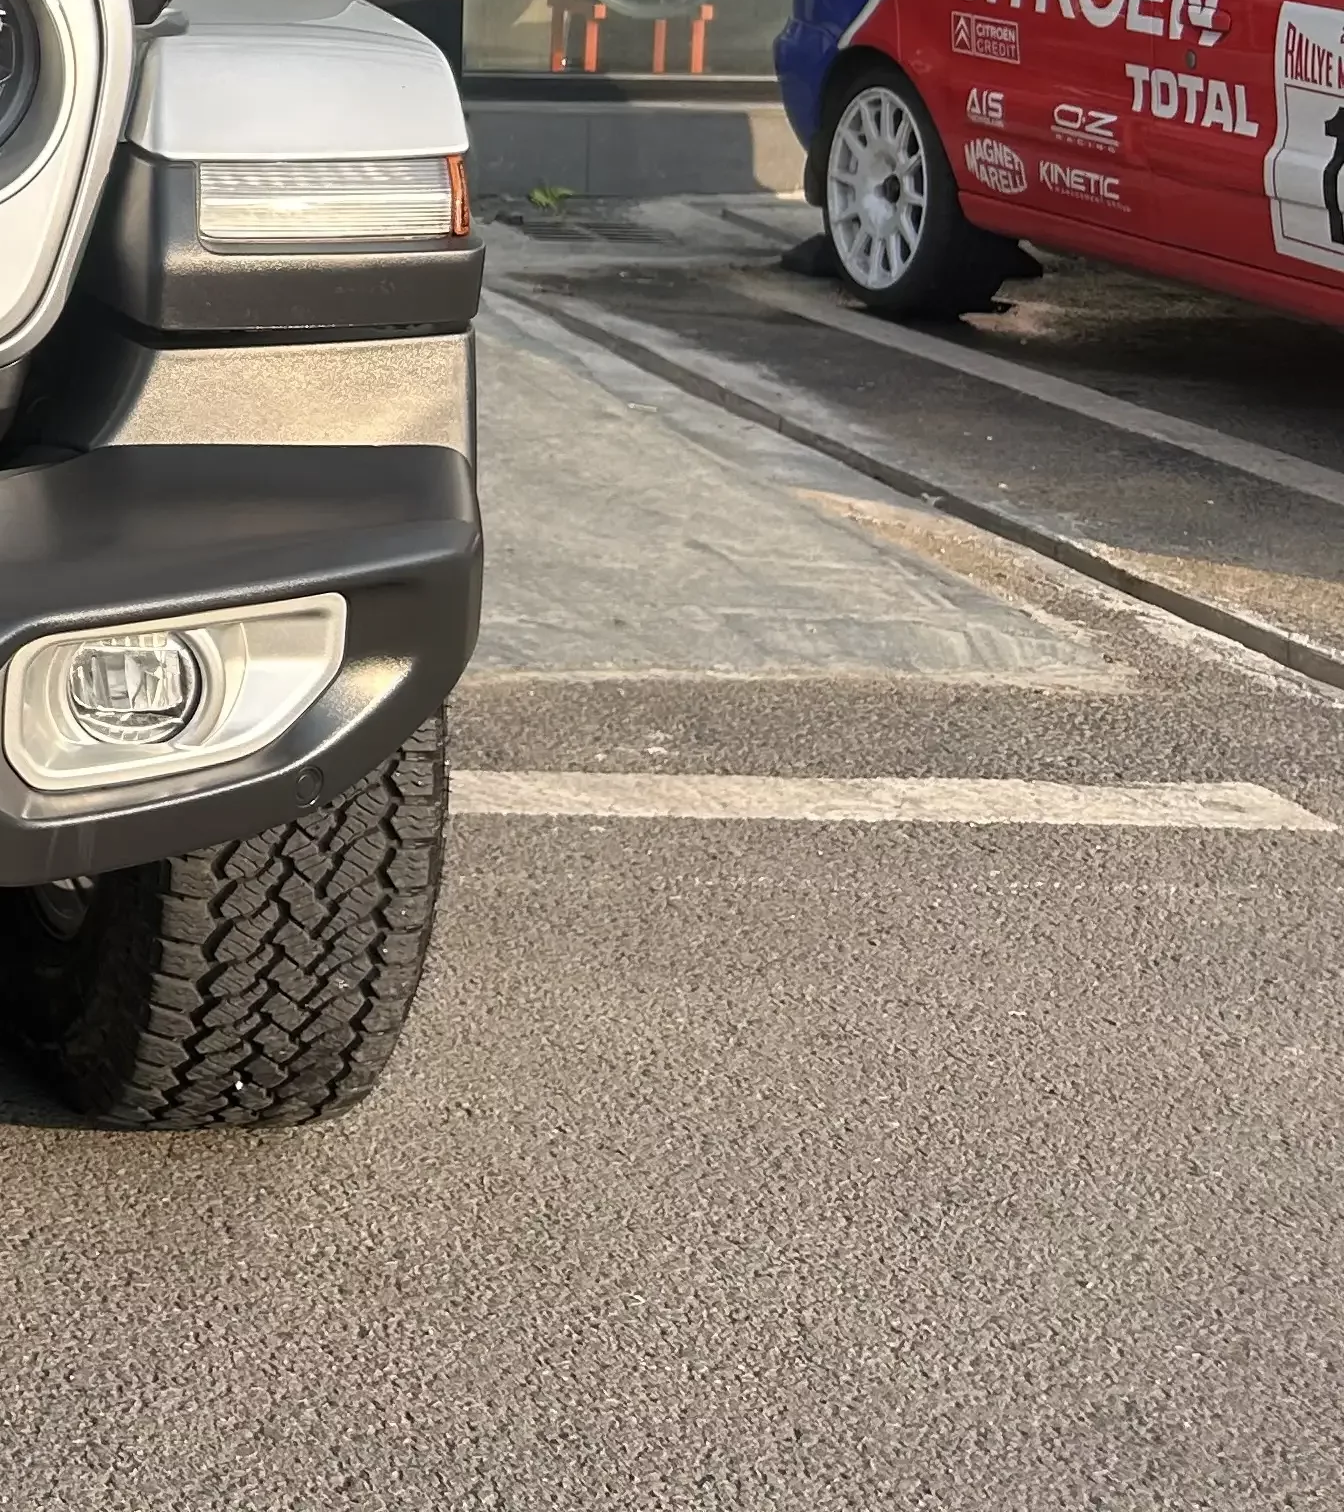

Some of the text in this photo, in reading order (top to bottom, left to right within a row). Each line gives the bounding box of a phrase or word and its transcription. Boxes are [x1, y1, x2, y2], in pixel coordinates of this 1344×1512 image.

[1285, 21, 1333, 88] RALLYE
[1125, 63, 1258, 138] TOTAL
[1039, 160, 1120, 201] KINETIC
